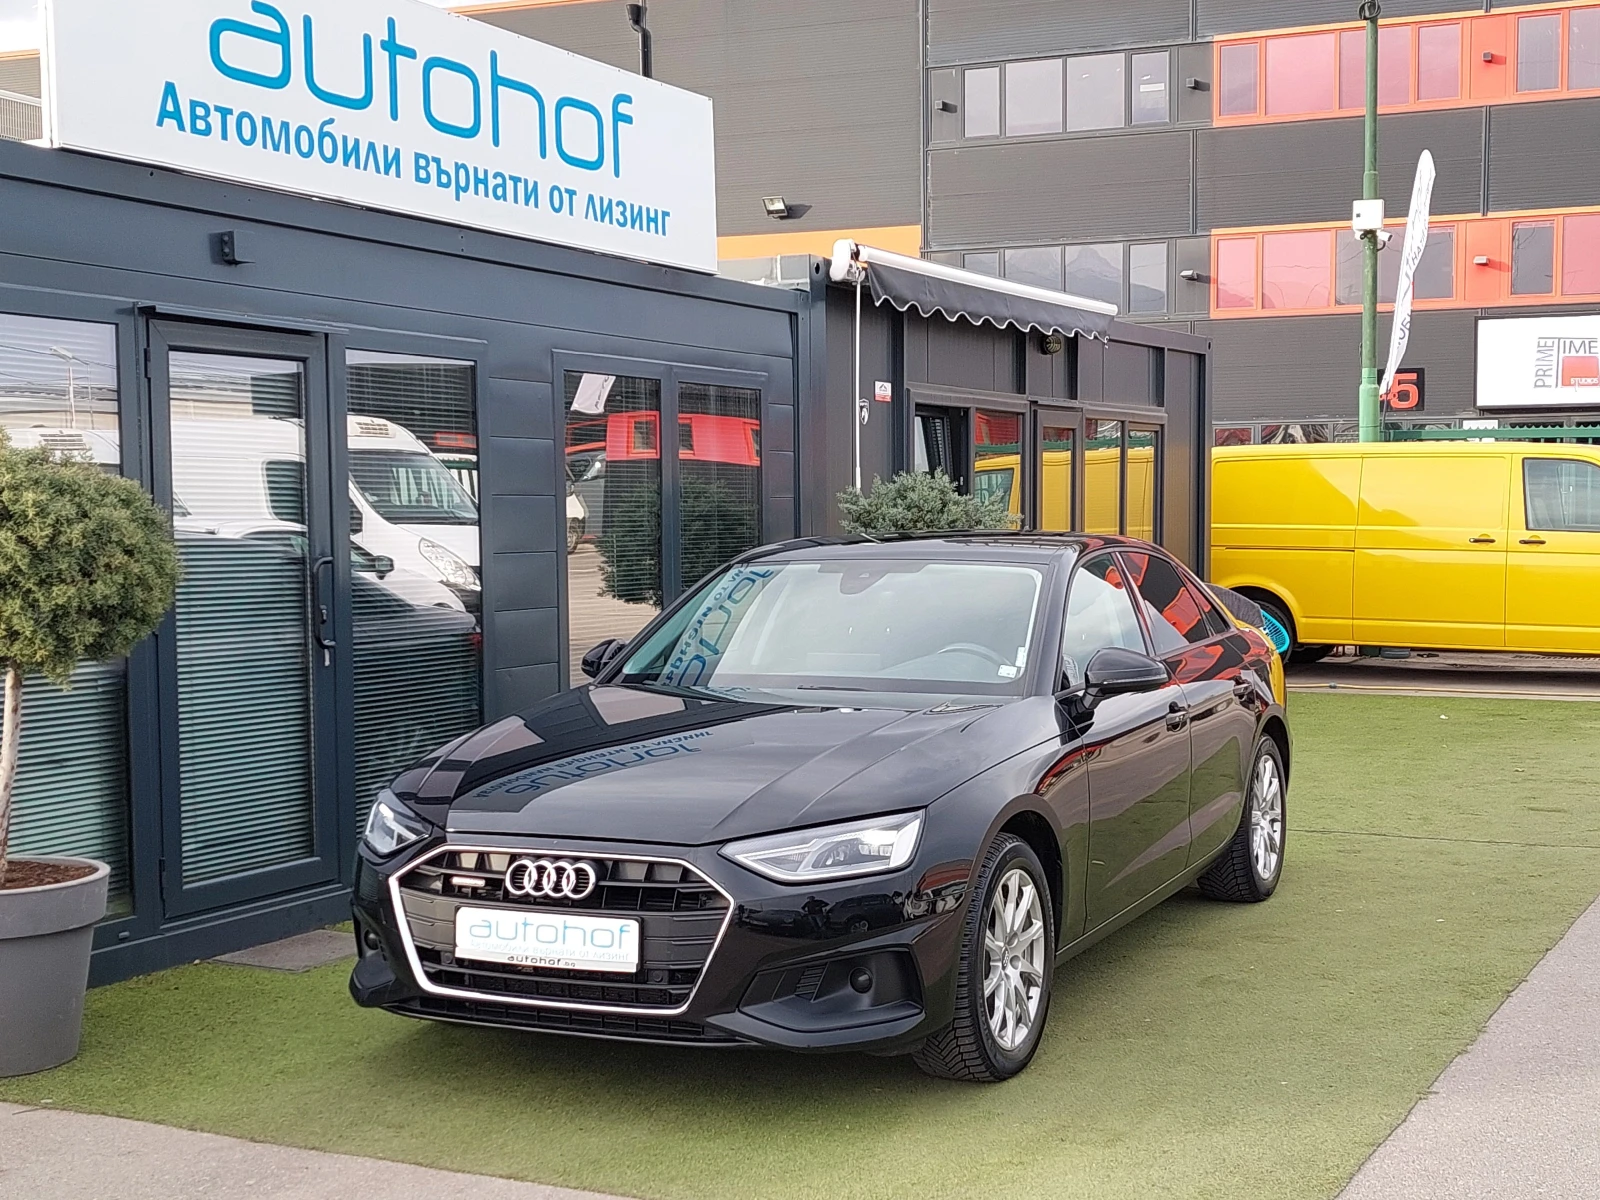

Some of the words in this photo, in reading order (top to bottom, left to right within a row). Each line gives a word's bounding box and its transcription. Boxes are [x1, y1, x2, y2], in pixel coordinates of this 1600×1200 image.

[210, 0, 634, 178] autohof
[156, 81, 402, 179] Автомобили
[414, 151, 540, 209] върнати
[549, 184, 577, 217] от
[585, 193, 671, 237] лизинг
[1533, 340, 1555, 388] PRIME
[469, 917, 631, 949] autohof
